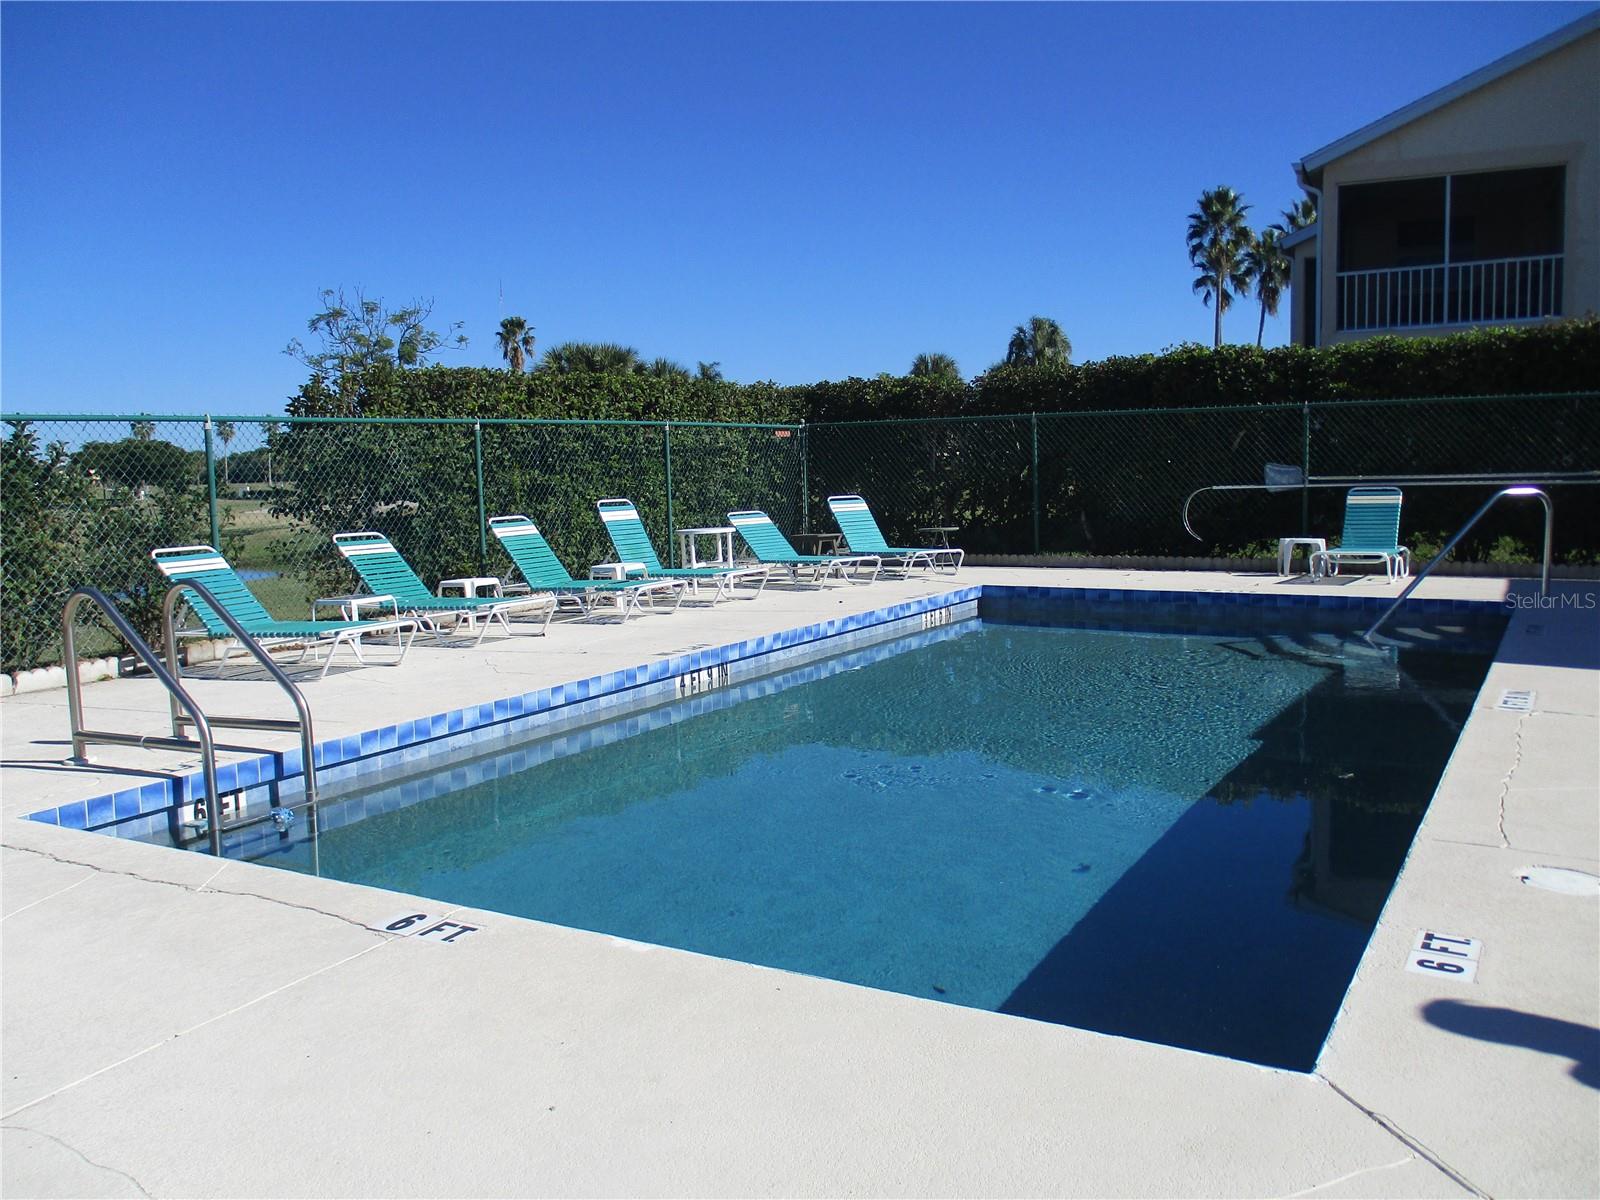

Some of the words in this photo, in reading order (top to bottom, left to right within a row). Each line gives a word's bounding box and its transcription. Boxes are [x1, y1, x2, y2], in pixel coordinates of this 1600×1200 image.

[194, 798, 207, 820] 6
[385, 913, 428, 931] 6
[1416, 959, 1465, 974] 6
